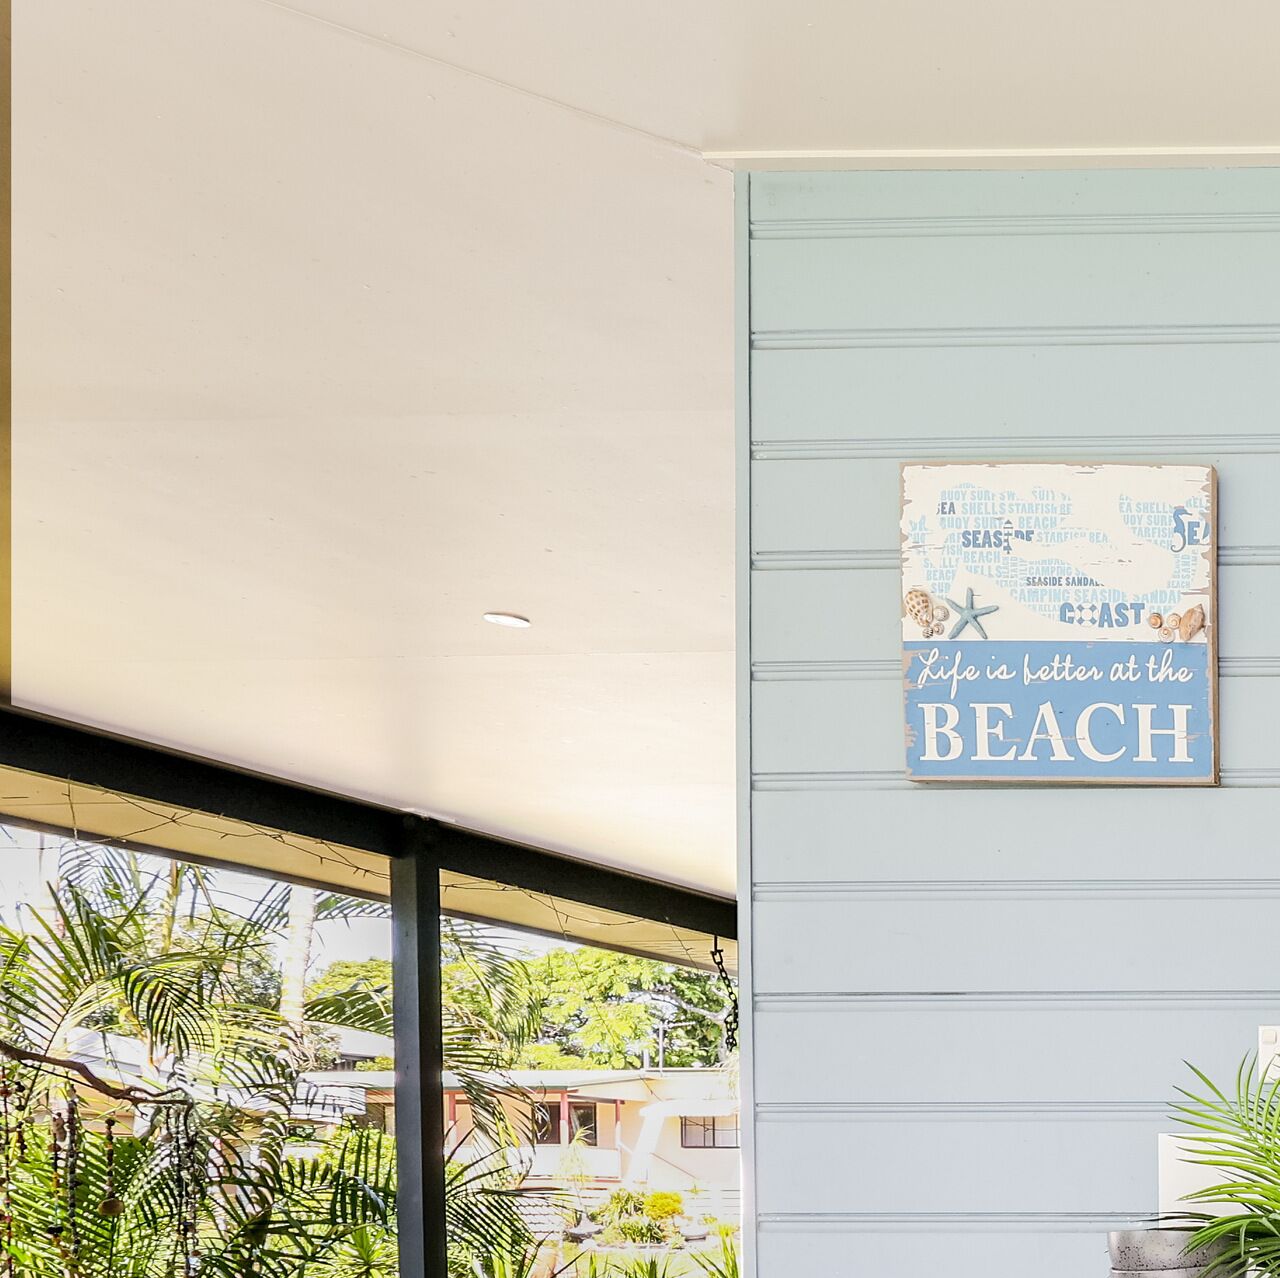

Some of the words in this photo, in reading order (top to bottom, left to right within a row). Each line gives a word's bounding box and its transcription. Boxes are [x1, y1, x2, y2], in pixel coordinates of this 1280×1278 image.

[961, 502, 1006, 515] SHELLS
[1018, 517, 1057, 529] BEACH
[1025, 577, 1062, 587] SEASIDE
[1065, 577, 1103, 587] SANDAL
[1059, 601, 1145, 628] COAST
[918, 647, 980, 700] Life
[986, 655, 1017, 681] is
[1023, 654, 1104, 686] better
[1109, 654, 1142, 682] at
[1145, 648, 1194, 683] the
[917, 700, 1194, 763] BEACH
